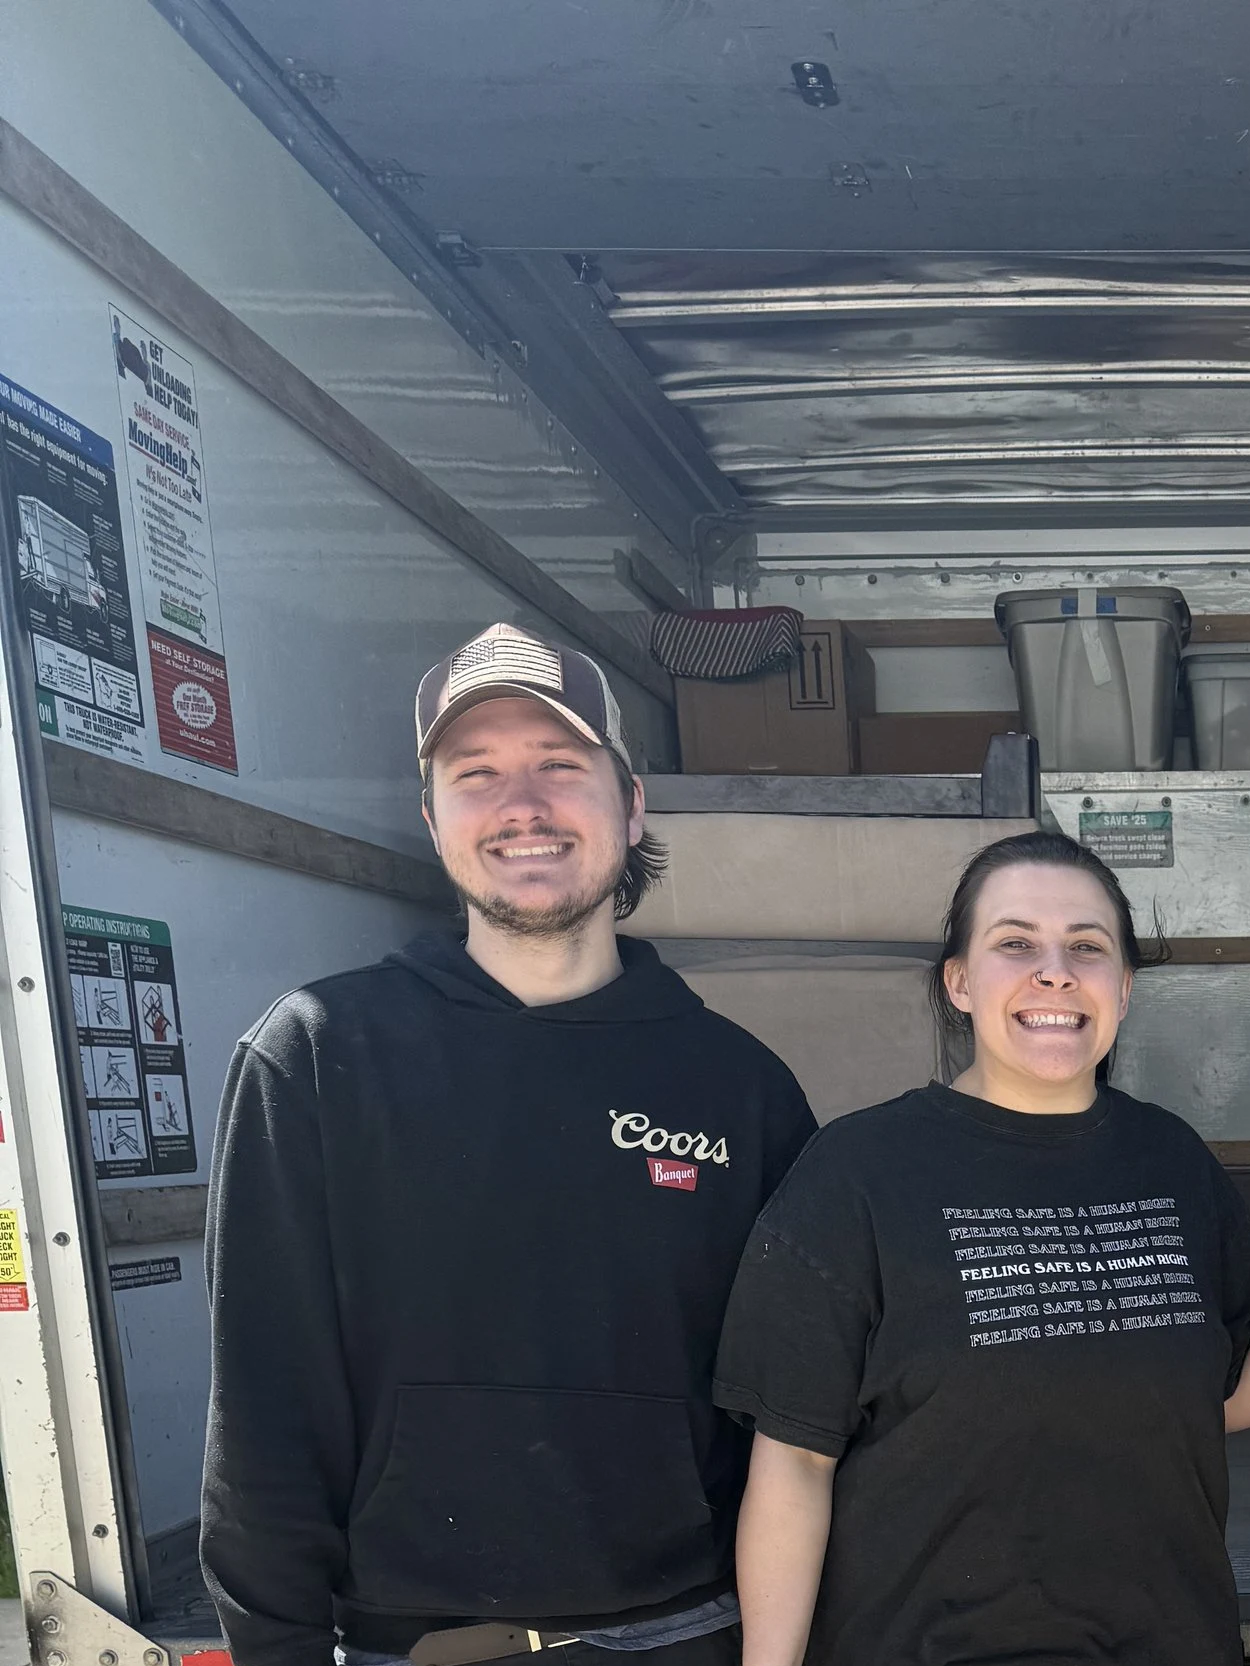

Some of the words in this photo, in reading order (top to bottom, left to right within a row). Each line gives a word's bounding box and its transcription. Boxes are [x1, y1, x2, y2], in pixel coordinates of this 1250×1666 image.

[149, 340, 163, 365] GET
[152, 361, 192, 405] UNLOADING
[10, 387, 39, 417] MOVING
[38, 404, 59, 430] MADE
[58, 416, 82, 444] EASIER
[154, 384, 173, 410] HELP
[172, 396, 198, 429] TODAY!
[133, 401, 153, 427] SAME
[152, 413, 165, 434] DAY
[165, 421, 190, 451] SERVICE
[19, 421, 30, 440] the
[30, 430, 46, 449] right
[46, 440, 77, 467] equipment
[156, 470, 168, 490] Not
[168, 477, 179, 496] Too
[179, 484, 192, 504] Late
[151, 640, 172, 657] NEED
[173, 648, 192, 665] SELF
[193, 657, 225, 680] STORAGE
[1103, 815, 1129, 827] SAVE
[69, 914, 105, 932] OPERATING
[105, 919, 151, 940] INSTRUCTIONS
[608, 1109, 730, 1164] Coors
[653, 1161, 696, 1184] Banquet
[942, 1207, 1012, 1219] FEELING
[1015, 1207, 1056, 1219] SAFE
[1057, 1207, 1075, 1218] IS
[1077, 1206, 1088, 1217] A
[1089, 1201, 1138, 1217] HUMAN
[1138, 1197, 1176, 1211] RIGHT
[0, 1222, 16, 1231] GHT
[949, 1225, 1020, 1241] FEELING
[1022, 1225, 1063, 1237] SAFE
[1063, 1225, 1080, 1237] IS
[1083, 1225, 1094, 1236] A
[1094, 1218, 1144, 1235] HUMAN
[1144, 1216, 1180, 1229] RIGHT
[954, 1243, 1026, 1262] FEELING
[1028, 1243, 1068, 1255] SAFE
[1069, 1243, 1086, 1255] IS
[1089, 1242, 1100, 1254] A
[1100, 1236, 1150, 1253] HUMAN
[1150, 1234, 1184, 1247] RIGHT
[960, 1263, 1031, 1281] FEELING
[1034, 1261, 1074, 1274] SAFE
[1075, 1261, 1092, 1273] IS
[1095, 1260, 1106, 1272] A
[1106, 1254, 1156, 1271] HUMAN
[1156, 1253, 1189, 1266] RIGHT
[965, 1283, 1035, 1304] FEELING
[1038, 1280, 1080, 1294] SAFE
[1081, 1279, 1098, 1292] IS
[1101, 1279, 1112, 1290] A
[1112, 1272, 1162, 1289] HUMAN
[1162, 1272, 1195, 1285] RIGHT
[968, 1303, 1040, 1325] FEELING
[1042, 1300, 1084, 1315] SAFE
[1086, 1298, 1103, 1312] IS
[1105, 1298, 1117, 1310] A
[1118, 1292, 1169, 1309] HUMAN
[1168, 1291, 1203, 1304] RIGHT
[969, 1325, 1041, 1348] FEELING
[1044, 1321, 1087, 1337] SAFE
[1088, 1319, 1105, 1334] IS
[1108, 1319, 1120, 1332] A
[1121, 1313, 1173, 1330] HUMAN
[1173, 1311, 1206, 1325] RIGHT
